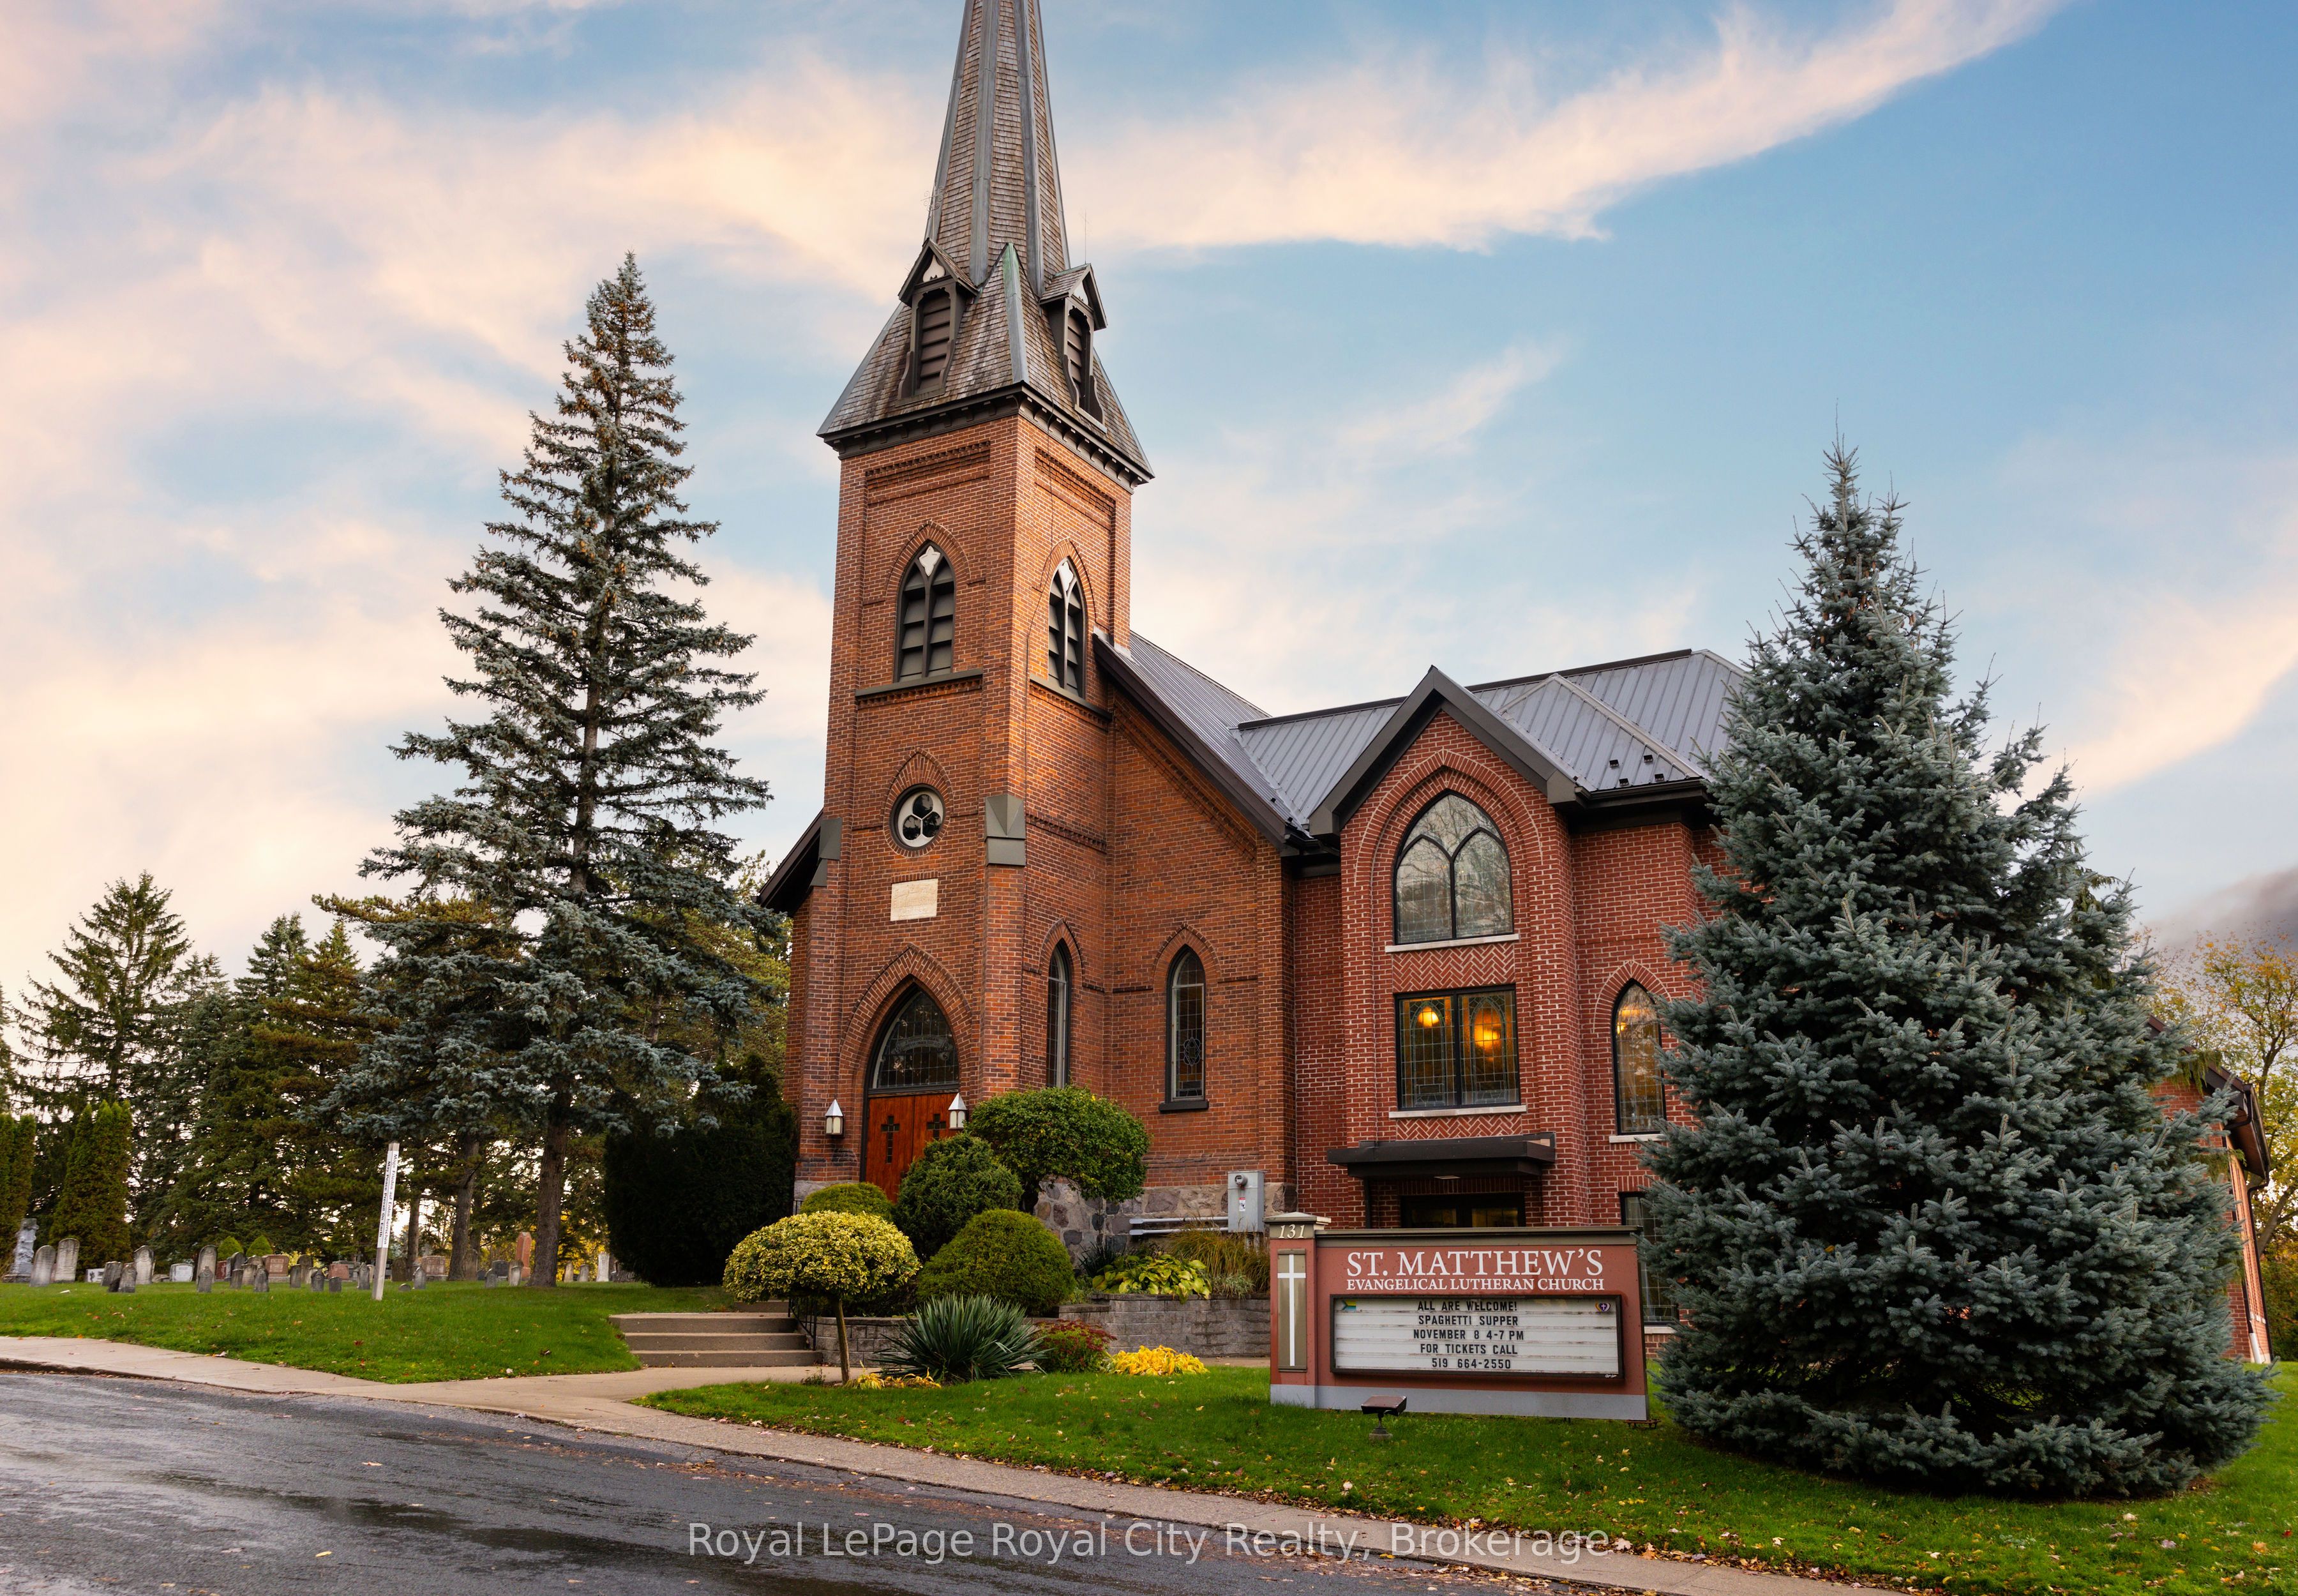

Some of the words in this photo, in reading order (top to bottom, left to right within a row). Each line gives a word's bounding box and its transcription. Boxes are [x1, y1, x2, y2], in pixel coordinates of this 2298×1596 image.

[1279, 1224, 1305, 1238] 131
[1347, 1252, 1388, 1276] ST.
[1397, 1248, 1603, 1276] MATTHEW'S
[1346, 1279, 1446, 1290] EVANGELICAL
[1450, 1279, 1535, 1290] LUTHERAN
[1537, 1278, 1605, 1290] CHURCH
[1418, 1301, 1436, 1311] ALL
[1441, 1301, 1460, 1311] ARE
[1466, 1301, 1517, 1311] WELCOME!
[1418, 1315, 1471, 1325] SPAGHETTI
[1480, 1316, 1518, 1326] SUPPER
[1413, 1329, 1466, 1339] NOVEMBER
[1474, 1330, 1479, 1339] 8
[1487, 1330, 1505, 1340] 4-7
[1509, 1330, 1524, 1340] PM
[1420, 1343, 1438, 1353] FOR
[1445, 1344, 1486, 1354] TICKETS
[1492, 1344, 1518, 1355] CALL
[1432, 1358, 1448, 1367] 519
[1457, 1359, 1511, 1369] 664-2550
